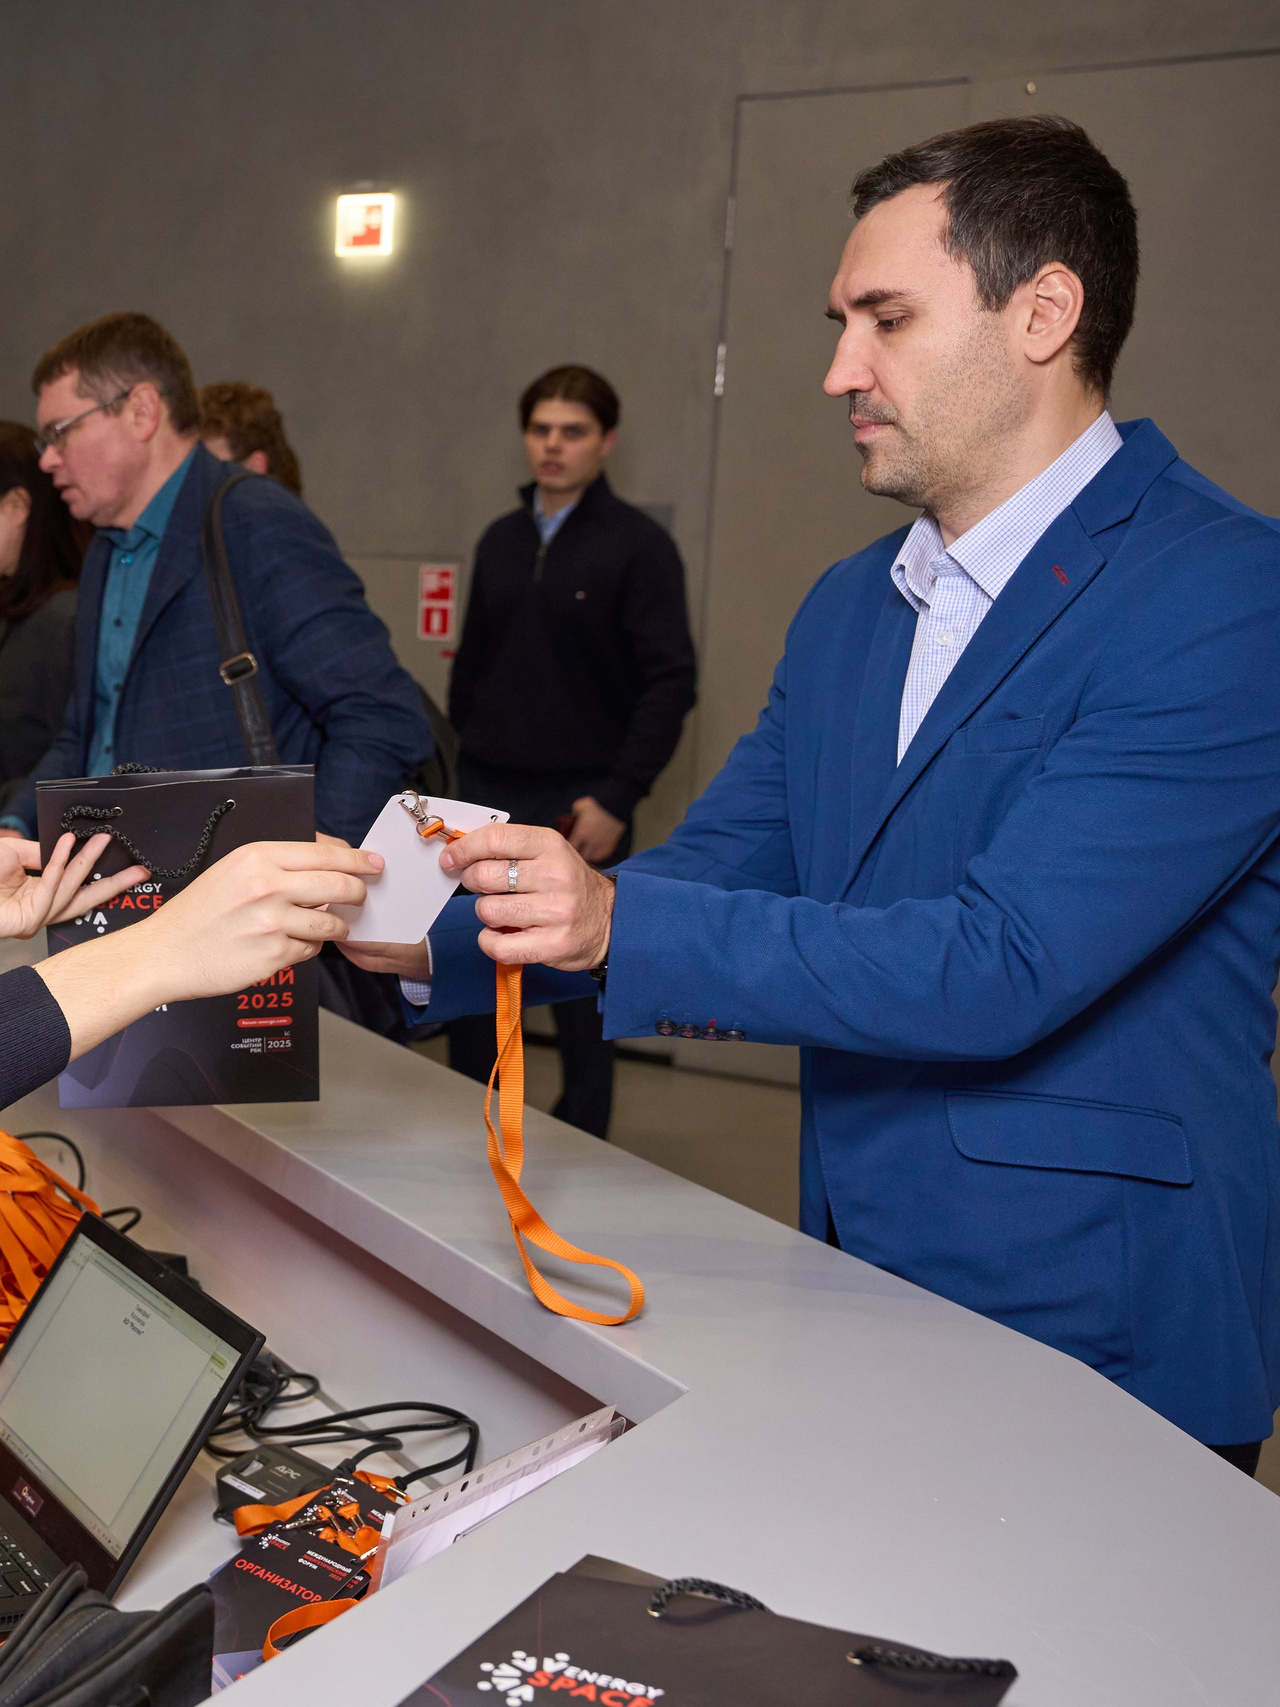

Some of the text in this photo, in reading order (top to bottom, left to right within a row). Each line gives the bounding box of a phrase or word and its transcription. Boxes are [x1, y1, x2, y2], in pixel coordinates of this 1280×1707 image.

[237, 992, 294, 1010] 2025
[267, 1040, 292, 1049] 2025
[275, 1465, 301, 1480] APC
[268, 1539, 288, 1550] SPACE
[298, 1558, 318, 1570] ФОРУМ
[301, 1554, 348, 1577] ЭНЕРГЕТИЧЕСКИЙ
[306, 1550, 352, 1574] МЕЖДУНАРОДНЫЙ
[234, 1558, 322, 1603] ОРГАНИЗАТОР
[527, 1670, 655, 1707] SPACE
[563, 1665, 665, 1700] ENERGY
